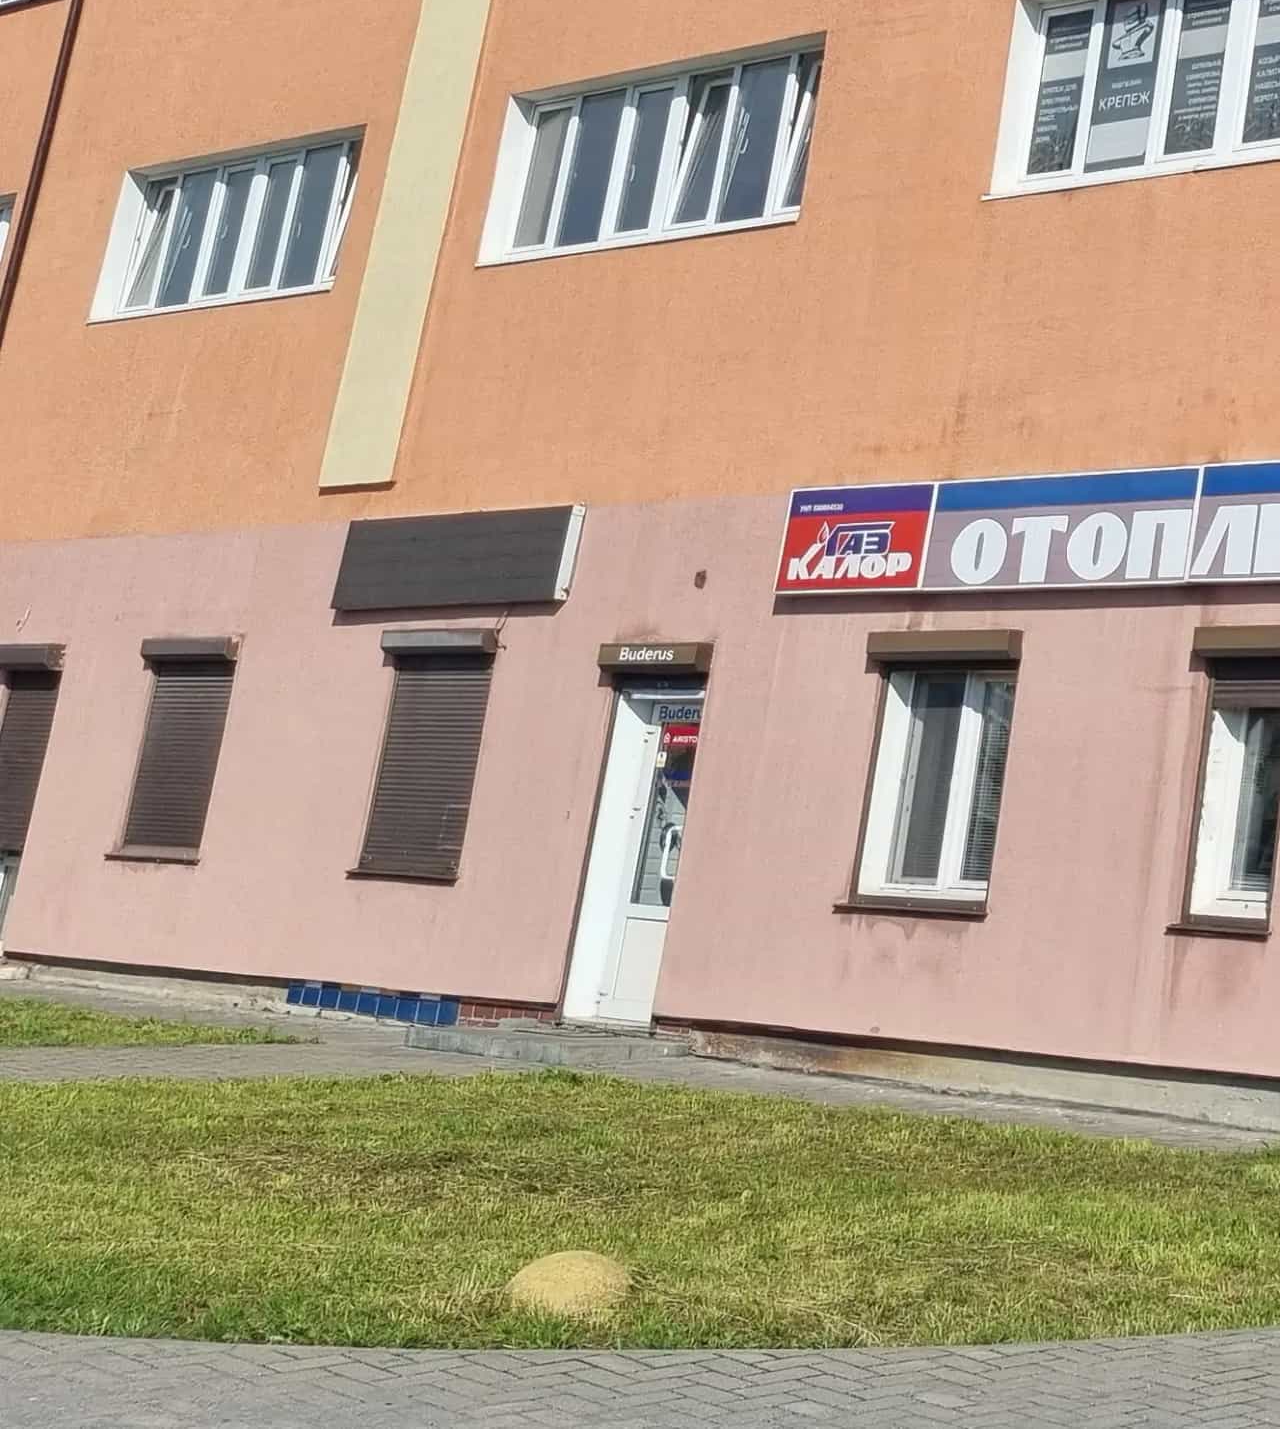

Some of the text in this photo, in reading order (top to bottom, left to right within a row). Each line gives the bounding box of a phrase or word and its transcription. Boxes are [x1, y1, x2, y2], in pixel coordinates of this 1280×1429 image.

[1098, 90, 1151, 111] КРЕПЕЖ
[824, 521, 895, 557] ГАЗ
[786, 542, 913, 581] КАЛОР
[619, 647, 674, 662] Buderus
